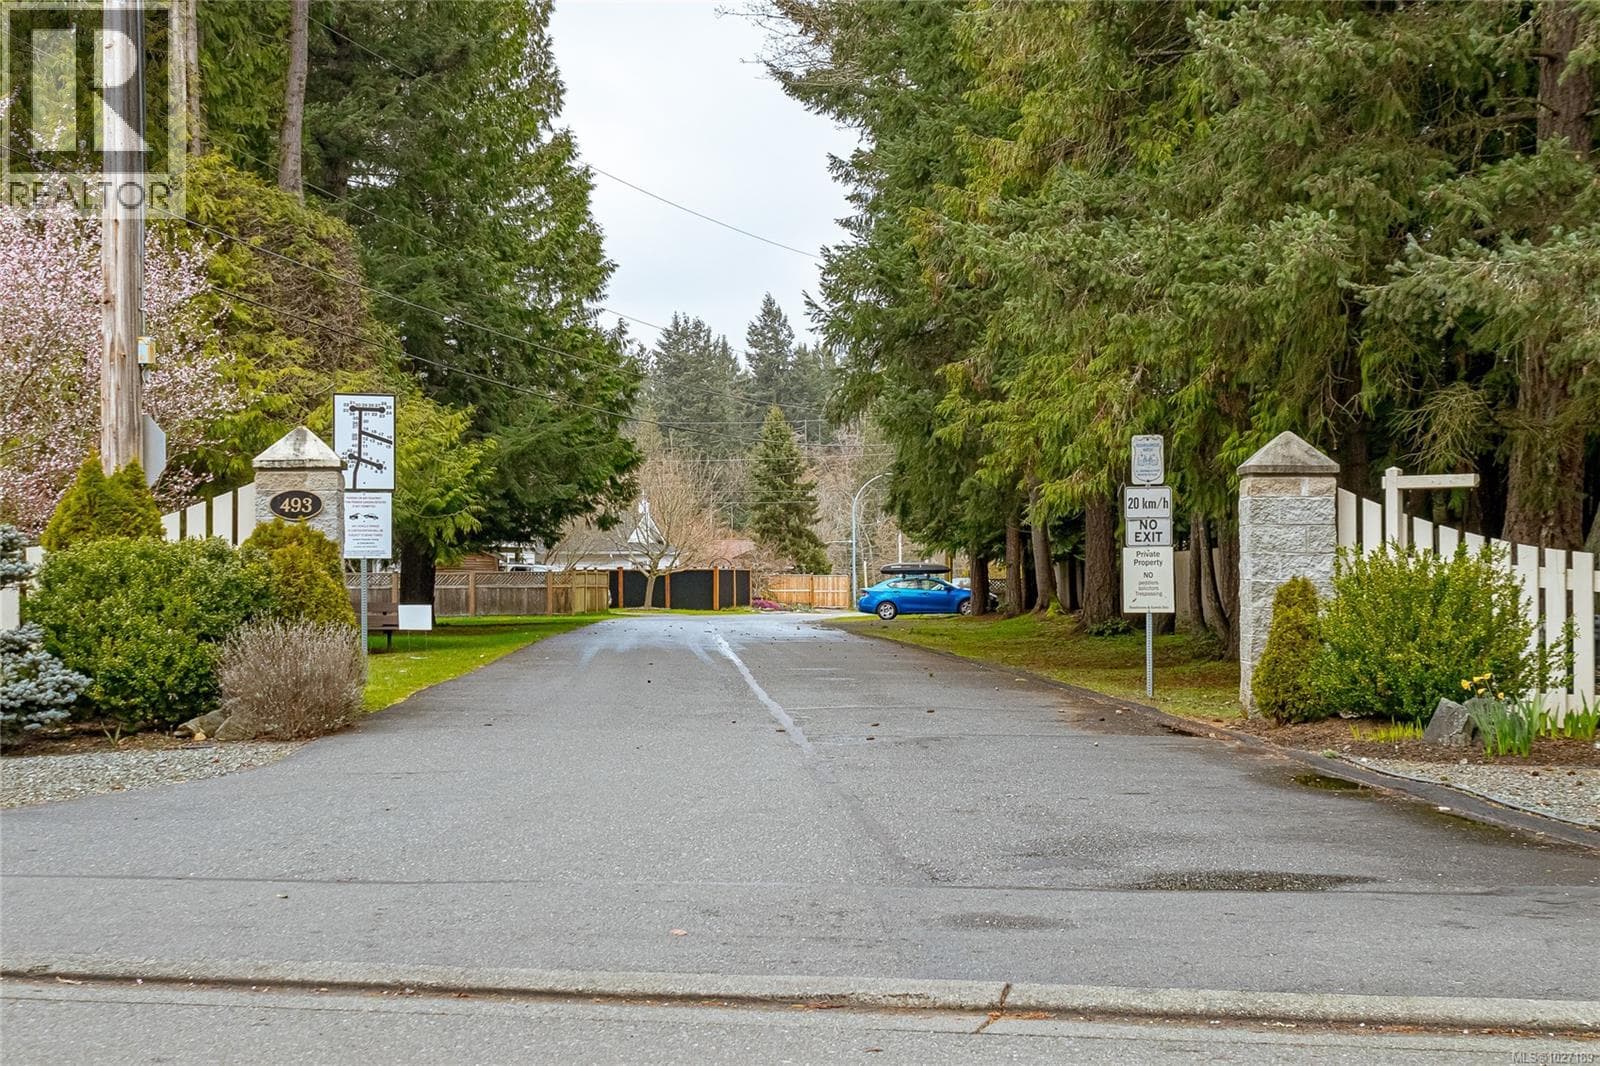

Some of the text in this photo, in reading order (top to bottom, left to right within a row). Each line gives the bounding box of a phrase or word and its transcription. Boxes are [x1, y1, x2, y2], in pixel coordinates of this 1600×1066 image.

[279, 497, 313, 513] 493
[1127, 497, 1169, 510] 20 km/h
[1139, 519, 1158, 530] NO
[1134, 532, 1163, 542] EXIT
[1135, 550, 1161, 558] Private
[1133, 559, 1163, 567] Property
